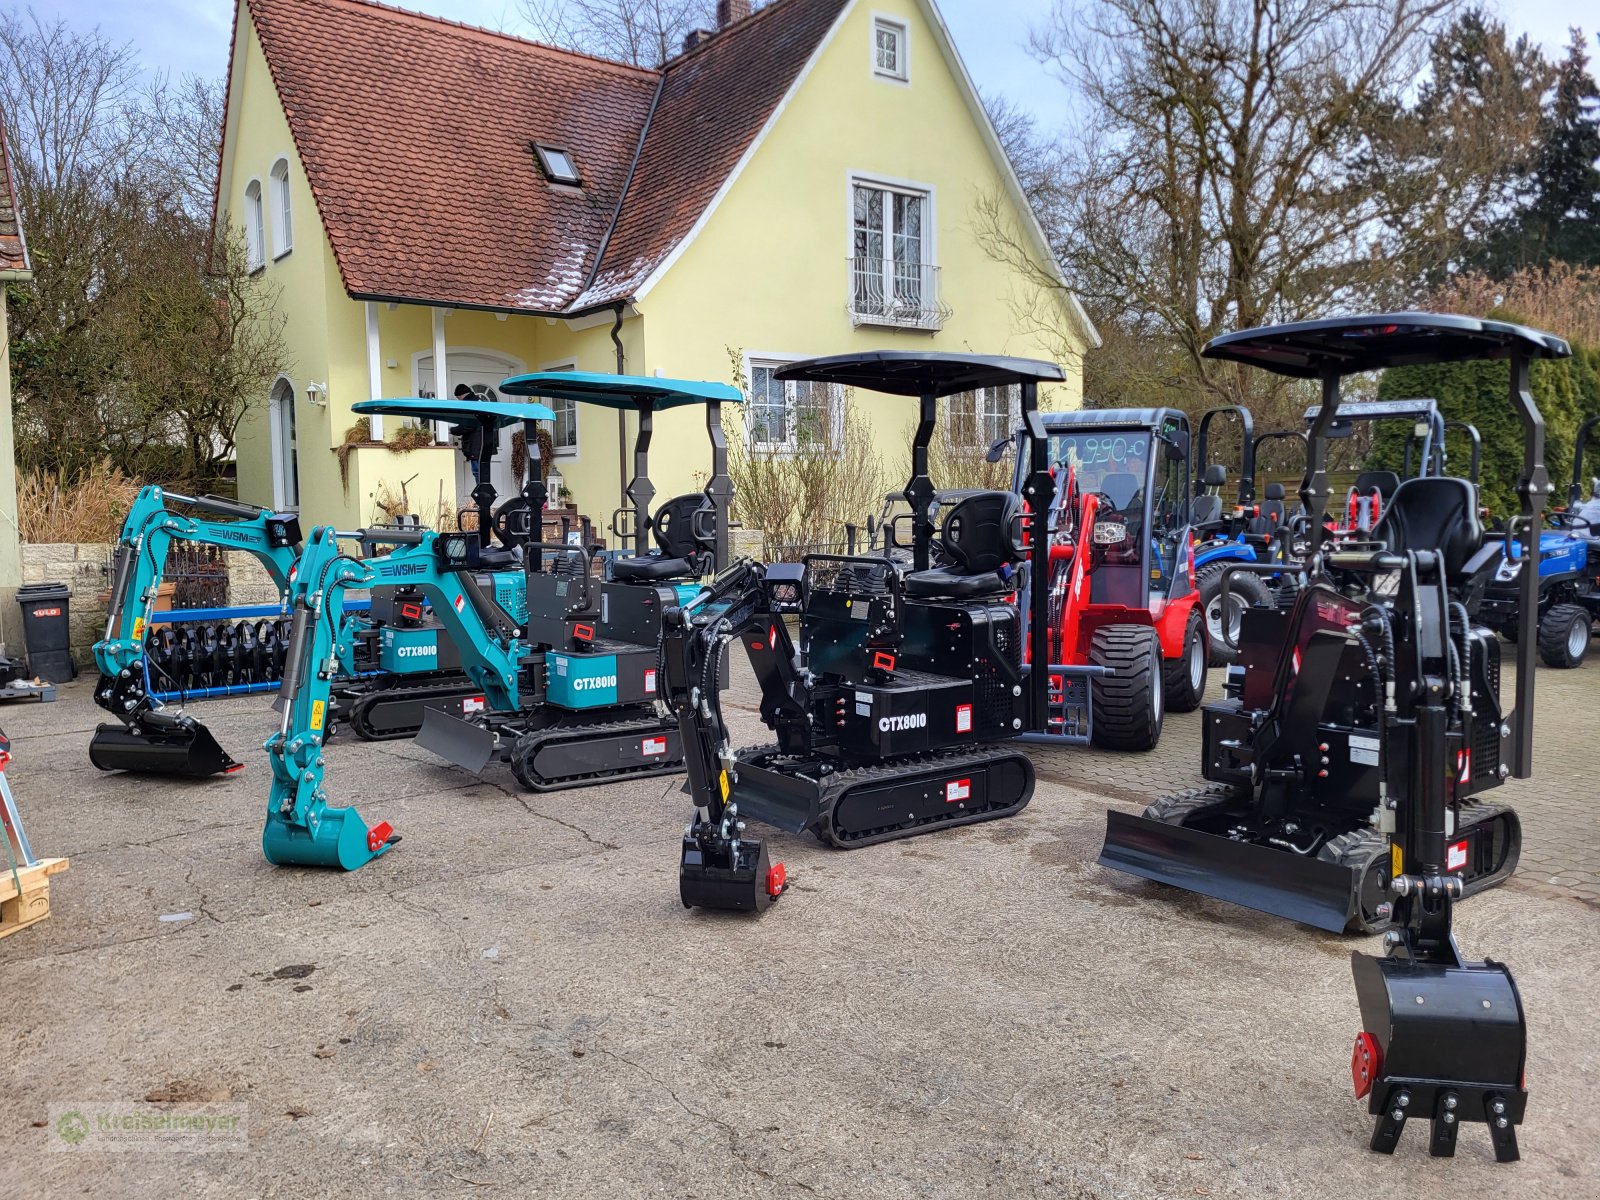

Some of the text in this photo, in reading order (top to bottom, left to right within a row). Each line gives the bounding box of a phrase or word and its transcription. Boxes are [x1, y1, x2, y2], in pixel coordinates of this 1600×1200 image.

[222, 530, 249, 542] WSM
[392, 563, 416, 576] WSM
[397, 645, 437, 657] CTX8010
[573, 675, 617, 691] CTX8010
[878, 713, 927, 732] CTX8010
